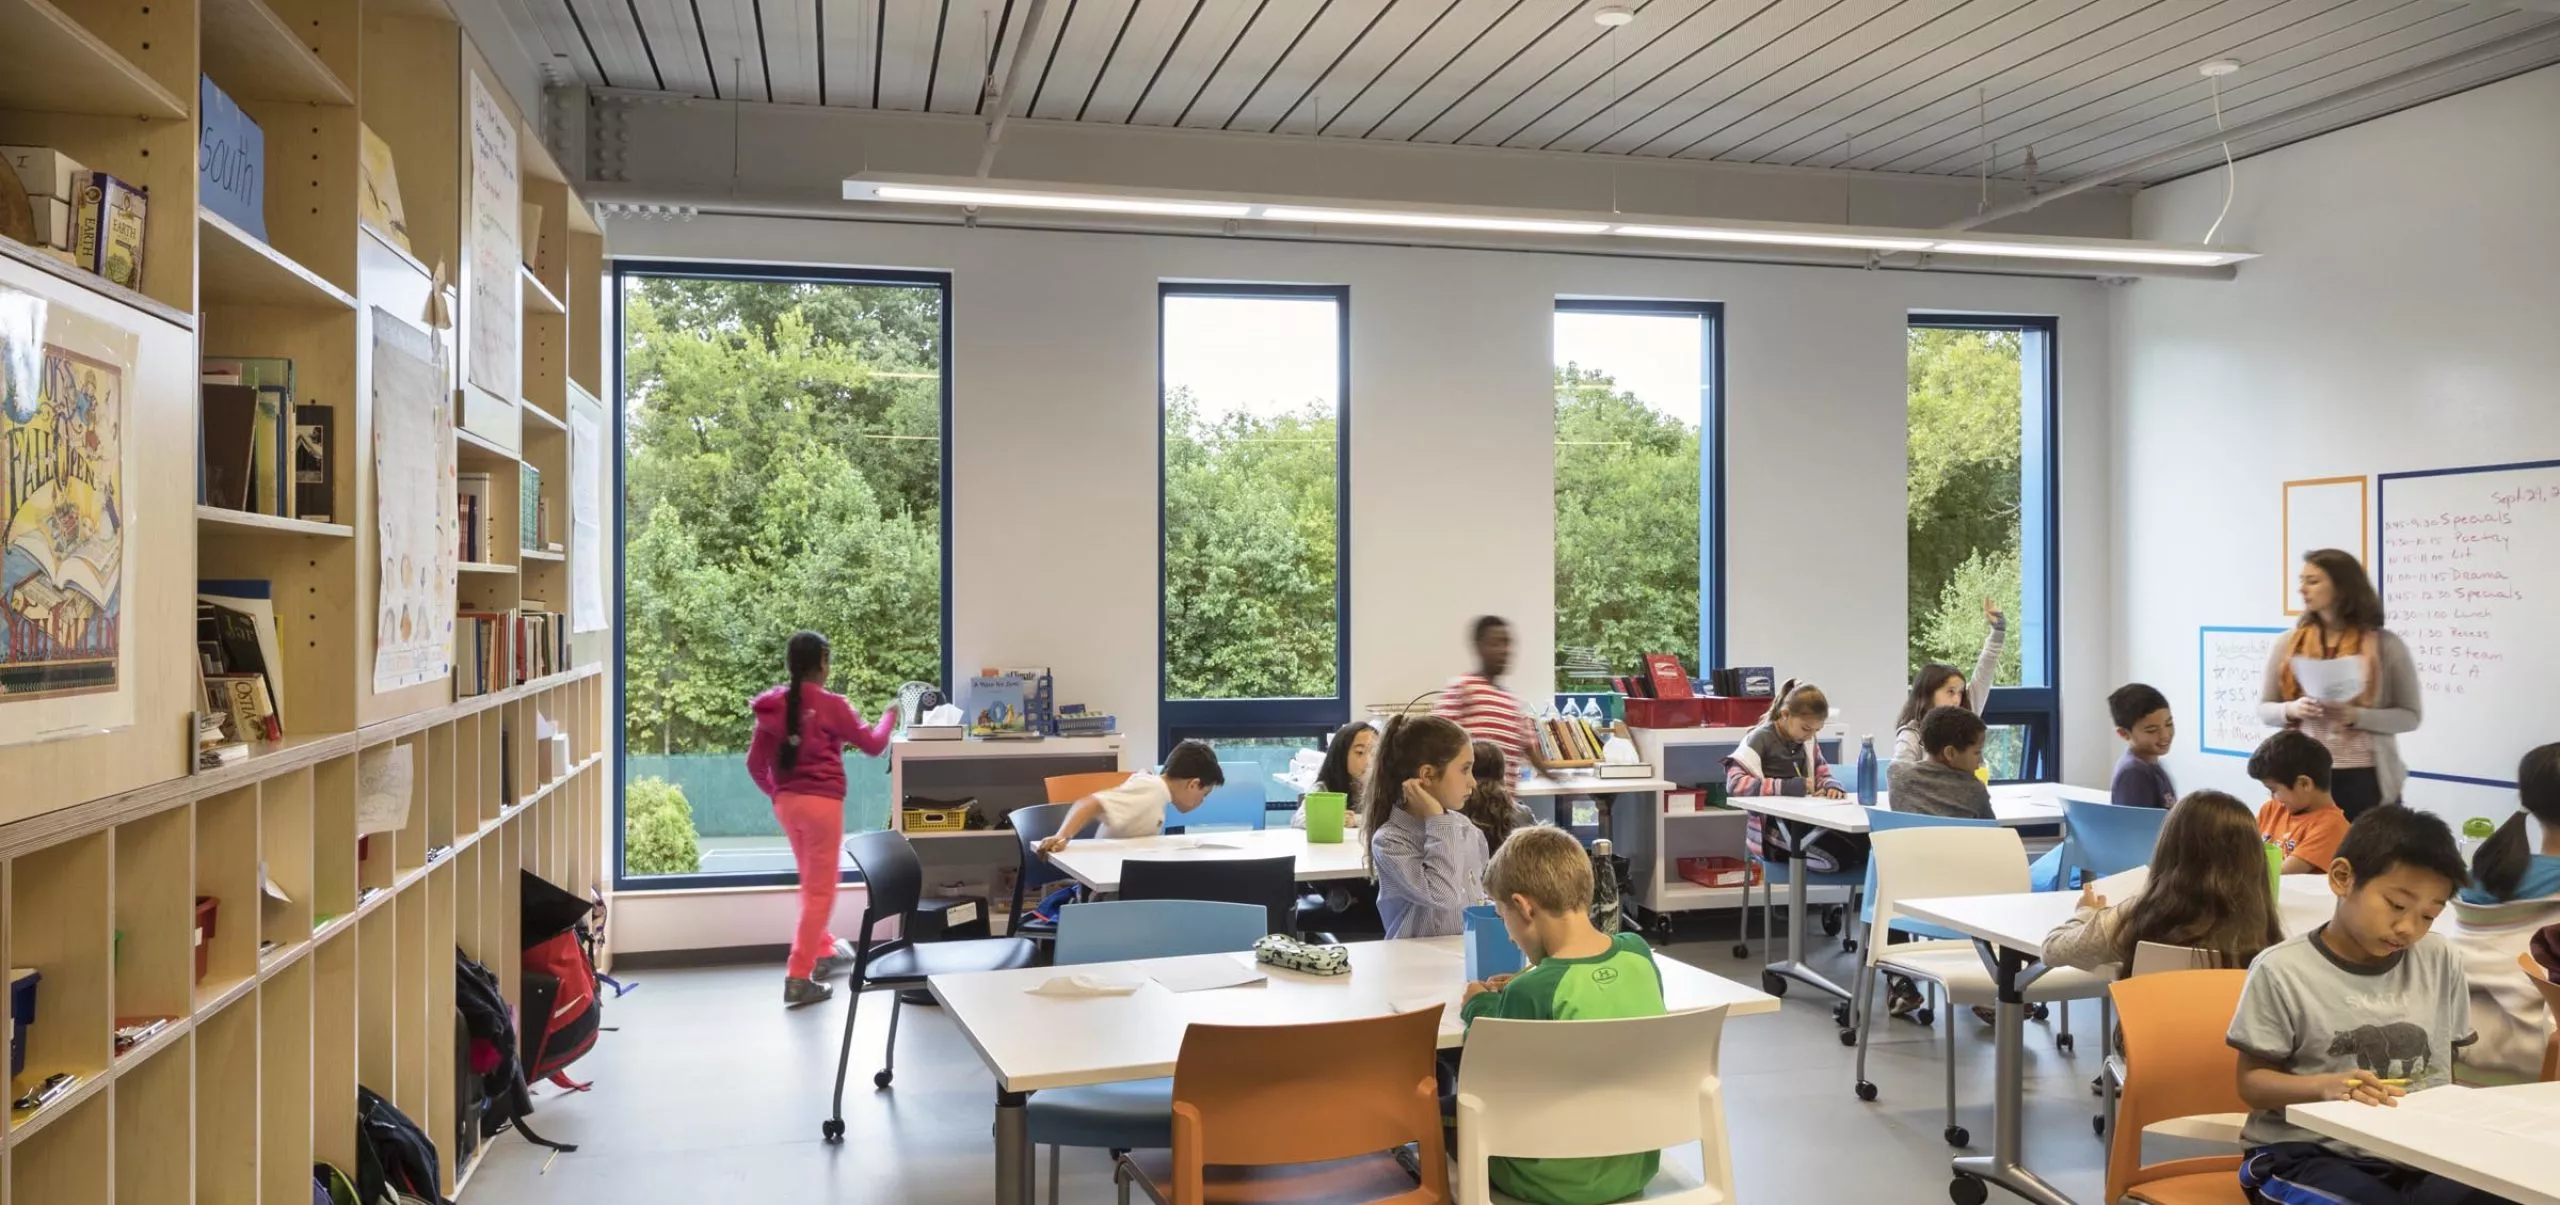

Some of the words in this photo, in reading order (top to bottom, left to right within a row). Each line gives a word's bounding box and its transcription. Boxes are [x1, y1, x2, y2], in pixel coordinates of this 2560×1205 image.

[200, 126, 254, 207] South
[82, 217, 96, 257] EARTH
[112, 218, 137, 240] EARTH
[4, 424, 54, 552] FALL
[2440, 511, 2512, 529] Specials
[2454, 583, 2523, 602] Specials
[2454, 607, 2493, 619] Lunch
[235, 681, 257, 720] OSTIA
